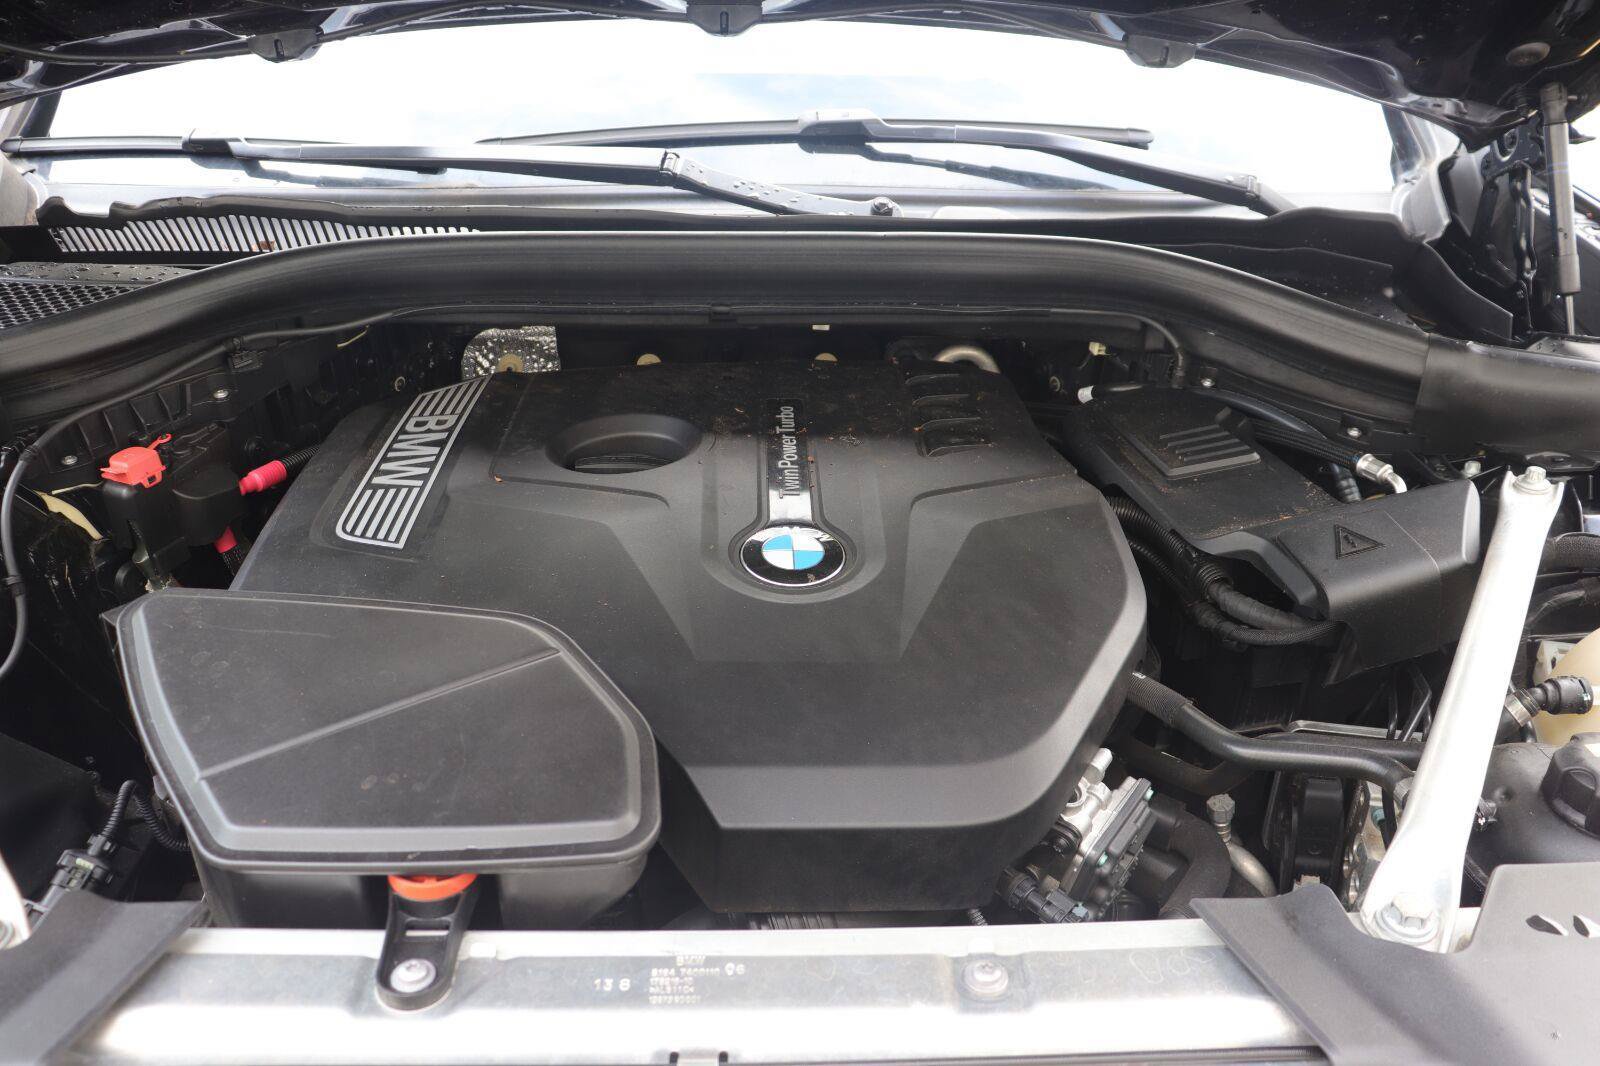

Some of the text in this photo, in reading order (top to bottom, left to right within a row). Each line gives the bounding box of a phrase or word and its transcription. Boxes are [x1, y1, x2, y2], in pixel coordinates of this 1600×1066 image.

[775, 405, 795, 434] Turbo
[371, 415, 460, 487] BMW
[594, 978, 613, 992] 13
